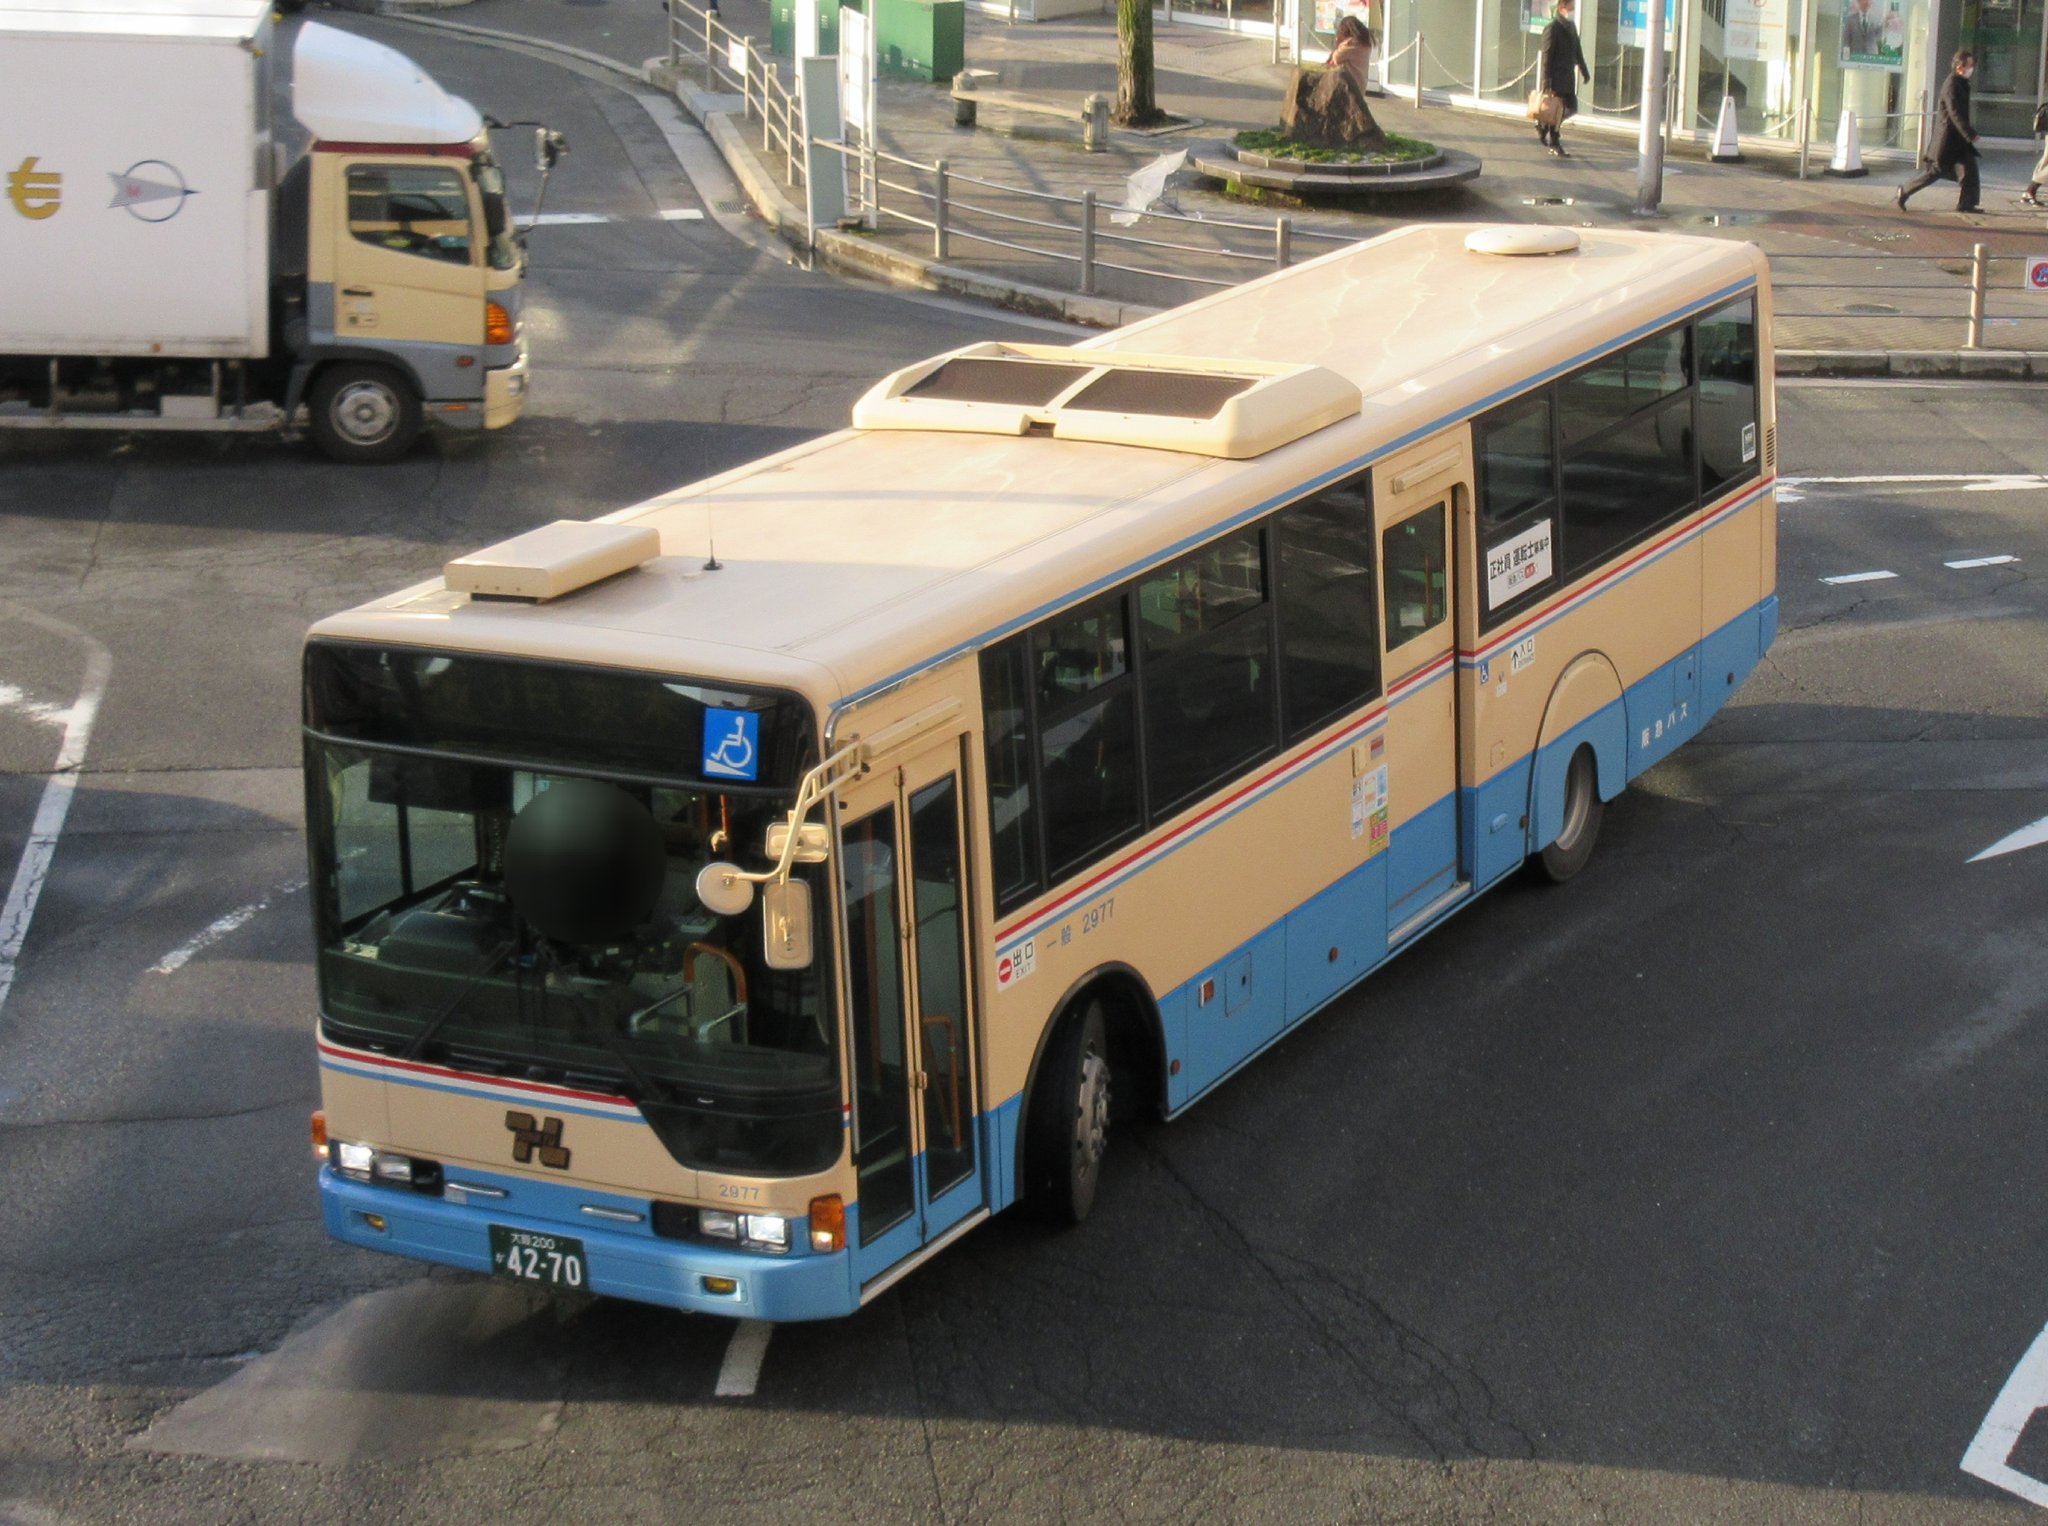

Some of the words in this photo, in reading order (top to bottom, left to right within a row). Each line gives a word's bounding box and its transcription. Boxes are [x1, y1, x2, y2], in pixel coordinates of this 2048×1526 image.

[1082, 897, 1114, 934] 2977
[1012, 942, 1034, 968] 出口
[719, 1183, 760, 1200] 2977
[507, 1245, 581, 1286] 42-70
